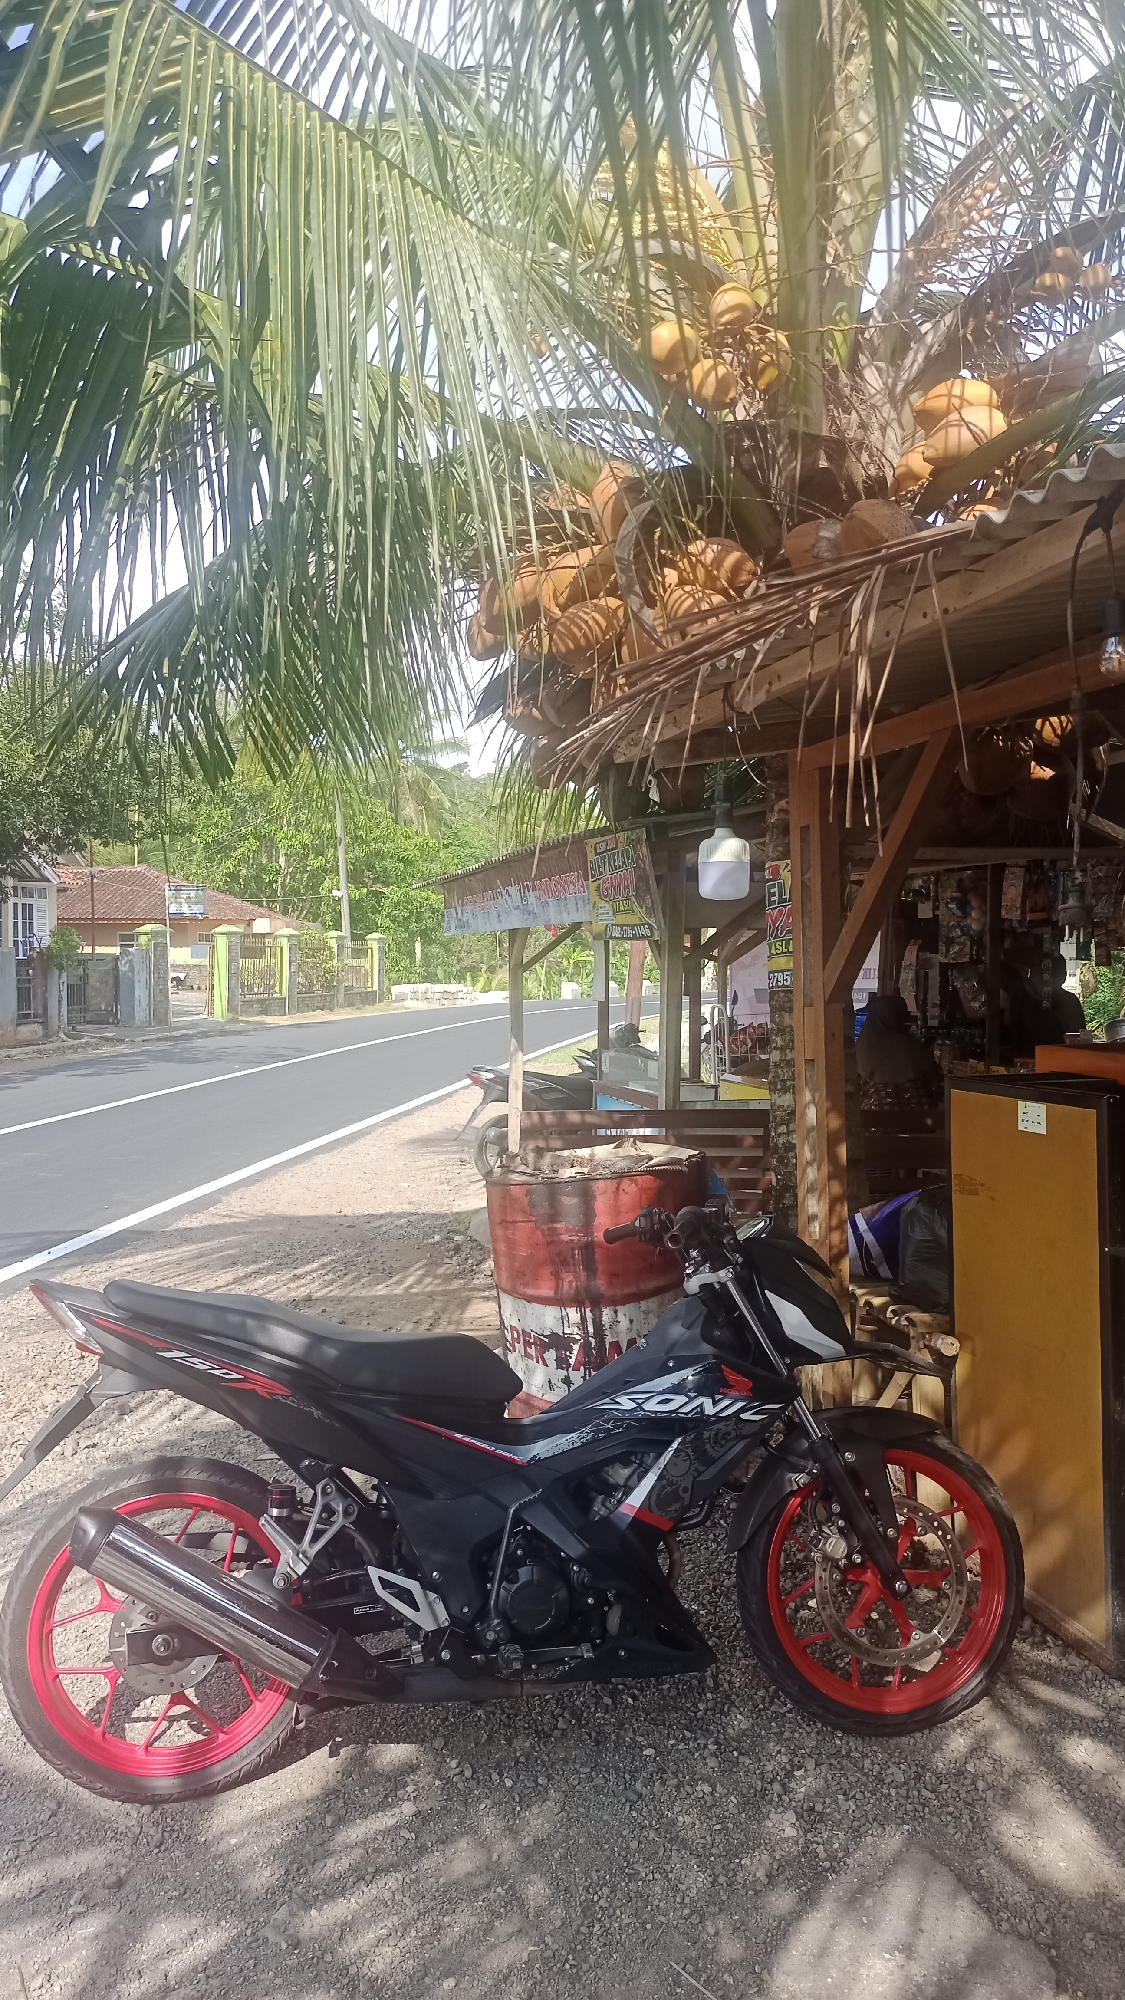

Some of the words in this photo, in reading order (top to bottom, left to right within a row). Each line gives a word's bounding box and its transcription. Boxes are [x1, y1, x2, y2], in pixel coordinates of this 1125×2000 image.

[155, 1349, 246, 1380] 150
[584, 1392, 786, 1421] SONIC
[719, 1387, 754, 1397] HONDA
